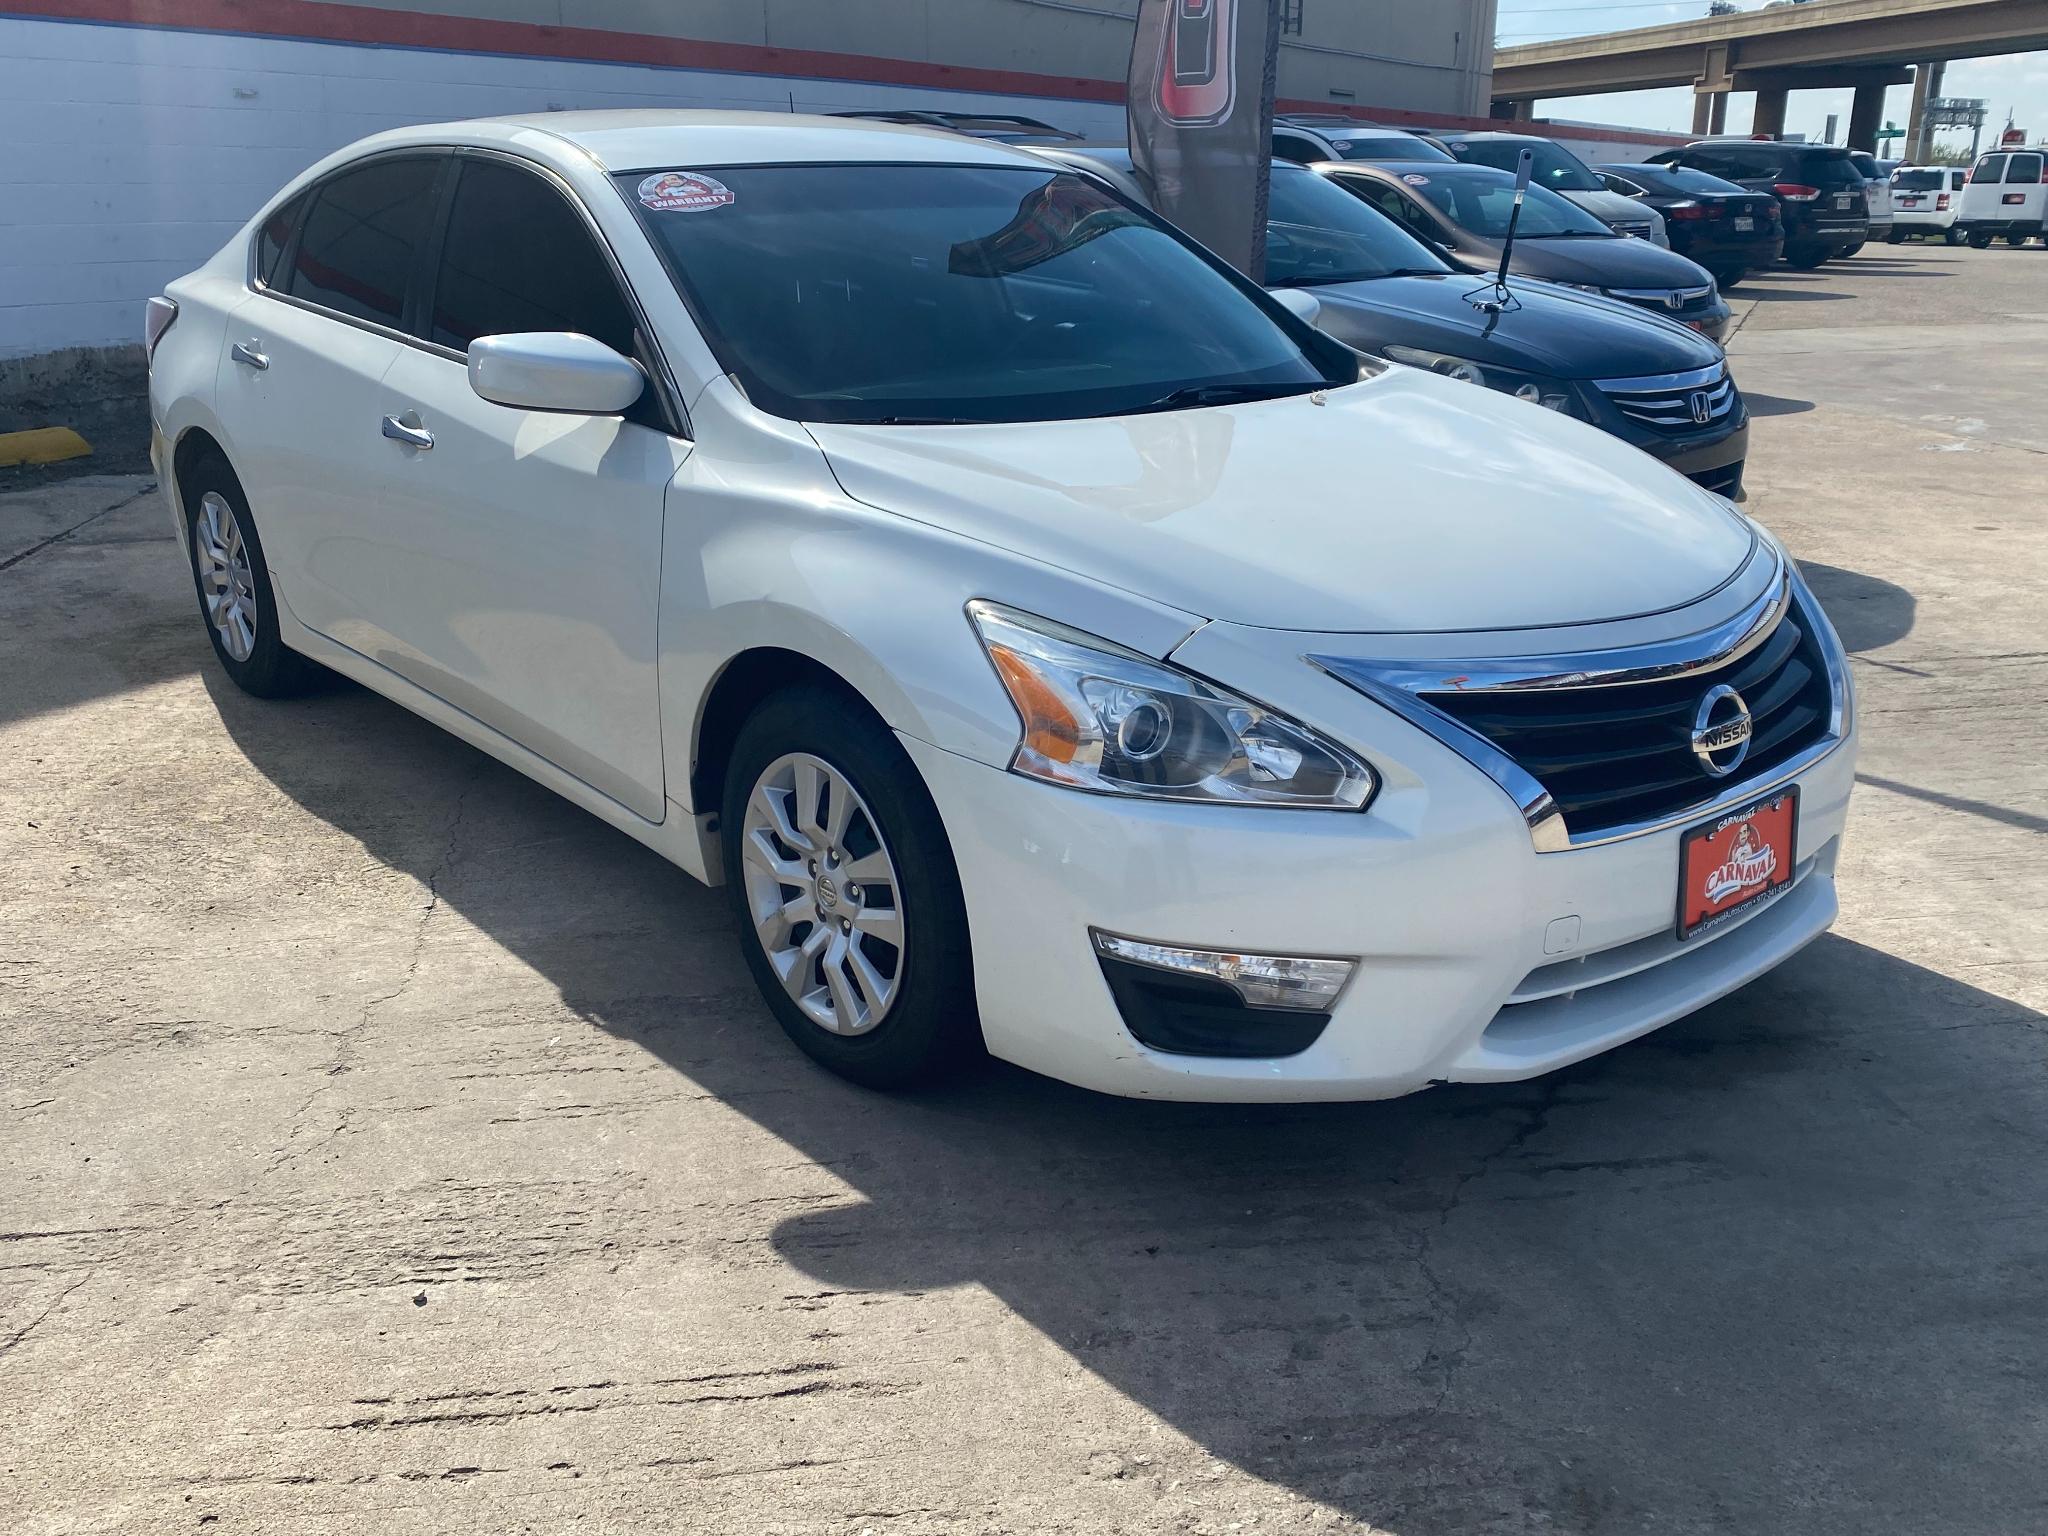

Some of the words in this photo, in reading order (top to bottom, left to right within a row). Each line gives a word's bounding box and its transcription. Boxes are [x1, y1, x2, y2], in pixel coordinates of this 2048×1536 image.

[653, 195, 726, 208] WARRANTY
[1705, 721, 1752, 748] NISSAN
[1717, 806, 1757, 833] CARNAVAL
[1705, 851, 1777, 896] CARNAVAL
